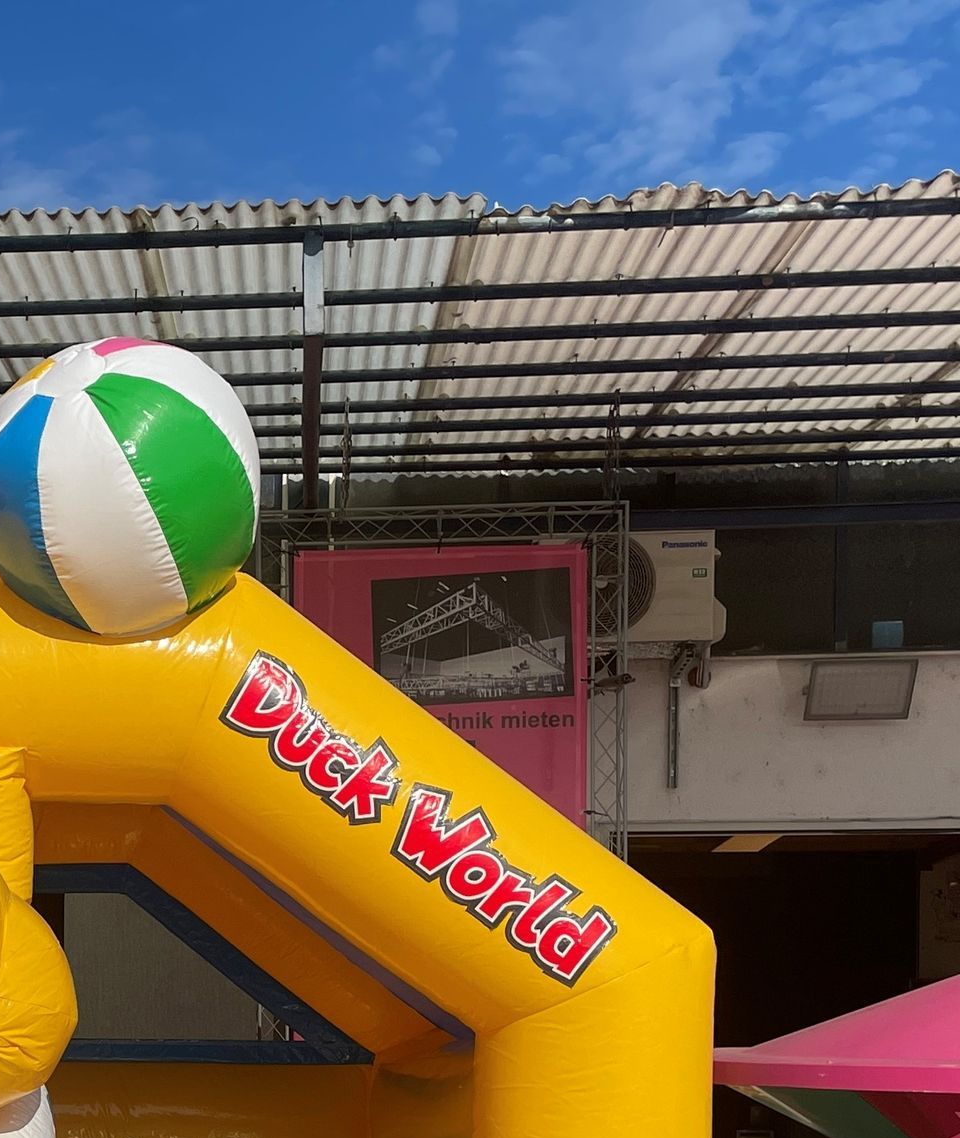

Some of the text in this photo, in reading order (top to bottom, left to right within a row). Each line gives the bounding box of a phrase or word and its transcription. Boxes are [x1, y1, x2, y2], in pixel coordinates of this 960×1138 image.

[661, 540, 708, 549] Panasonic
[438, 711, 575, 730] hnik mieten
[222, 653, 614, 984] Duck World
